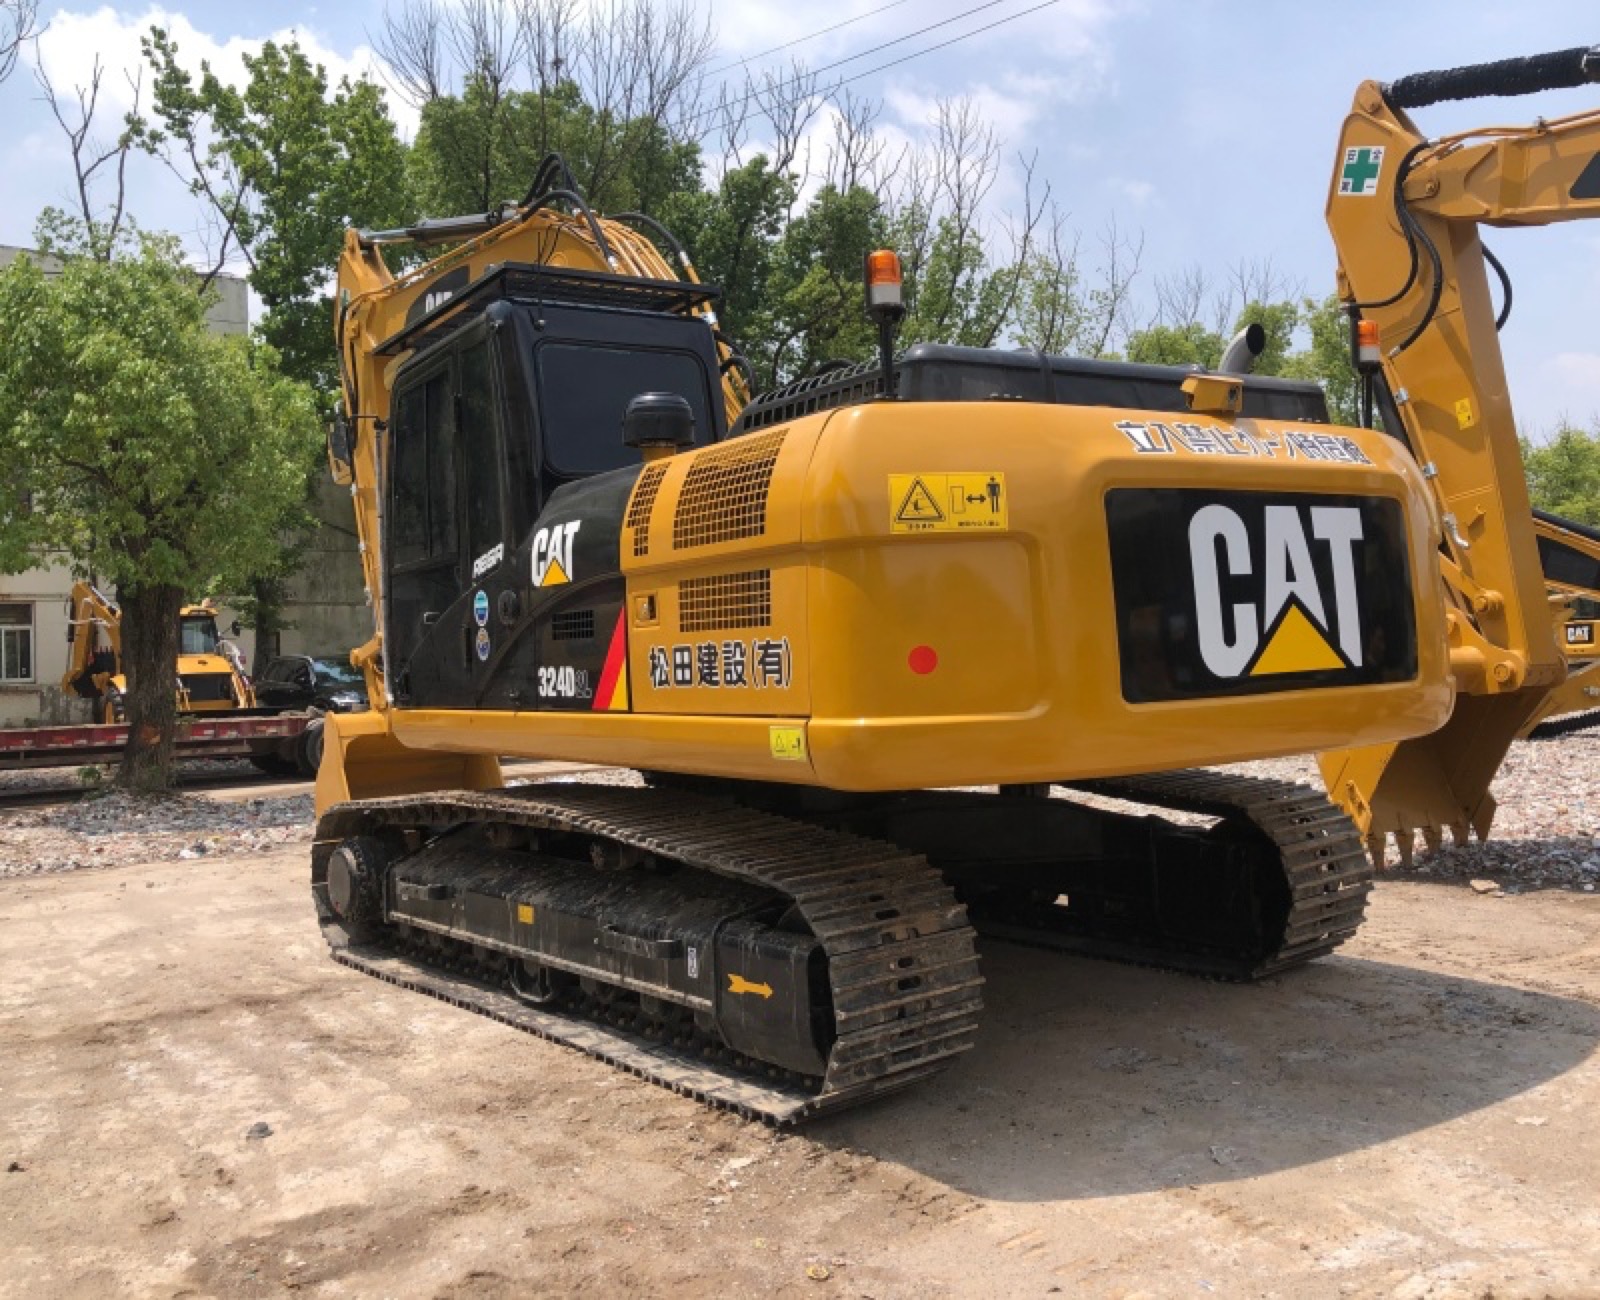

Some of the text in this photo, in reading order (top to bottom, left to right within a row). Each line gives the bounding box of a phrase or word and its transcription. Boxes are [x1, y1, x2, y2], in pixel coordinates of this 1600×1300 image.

[532, 520, 582, 587] CAT
[1188, 504, 1364, 678] CAT
[649, 636, 792, 690] 松田建設(有)
[1567, 626, 1589, 641] CAT
